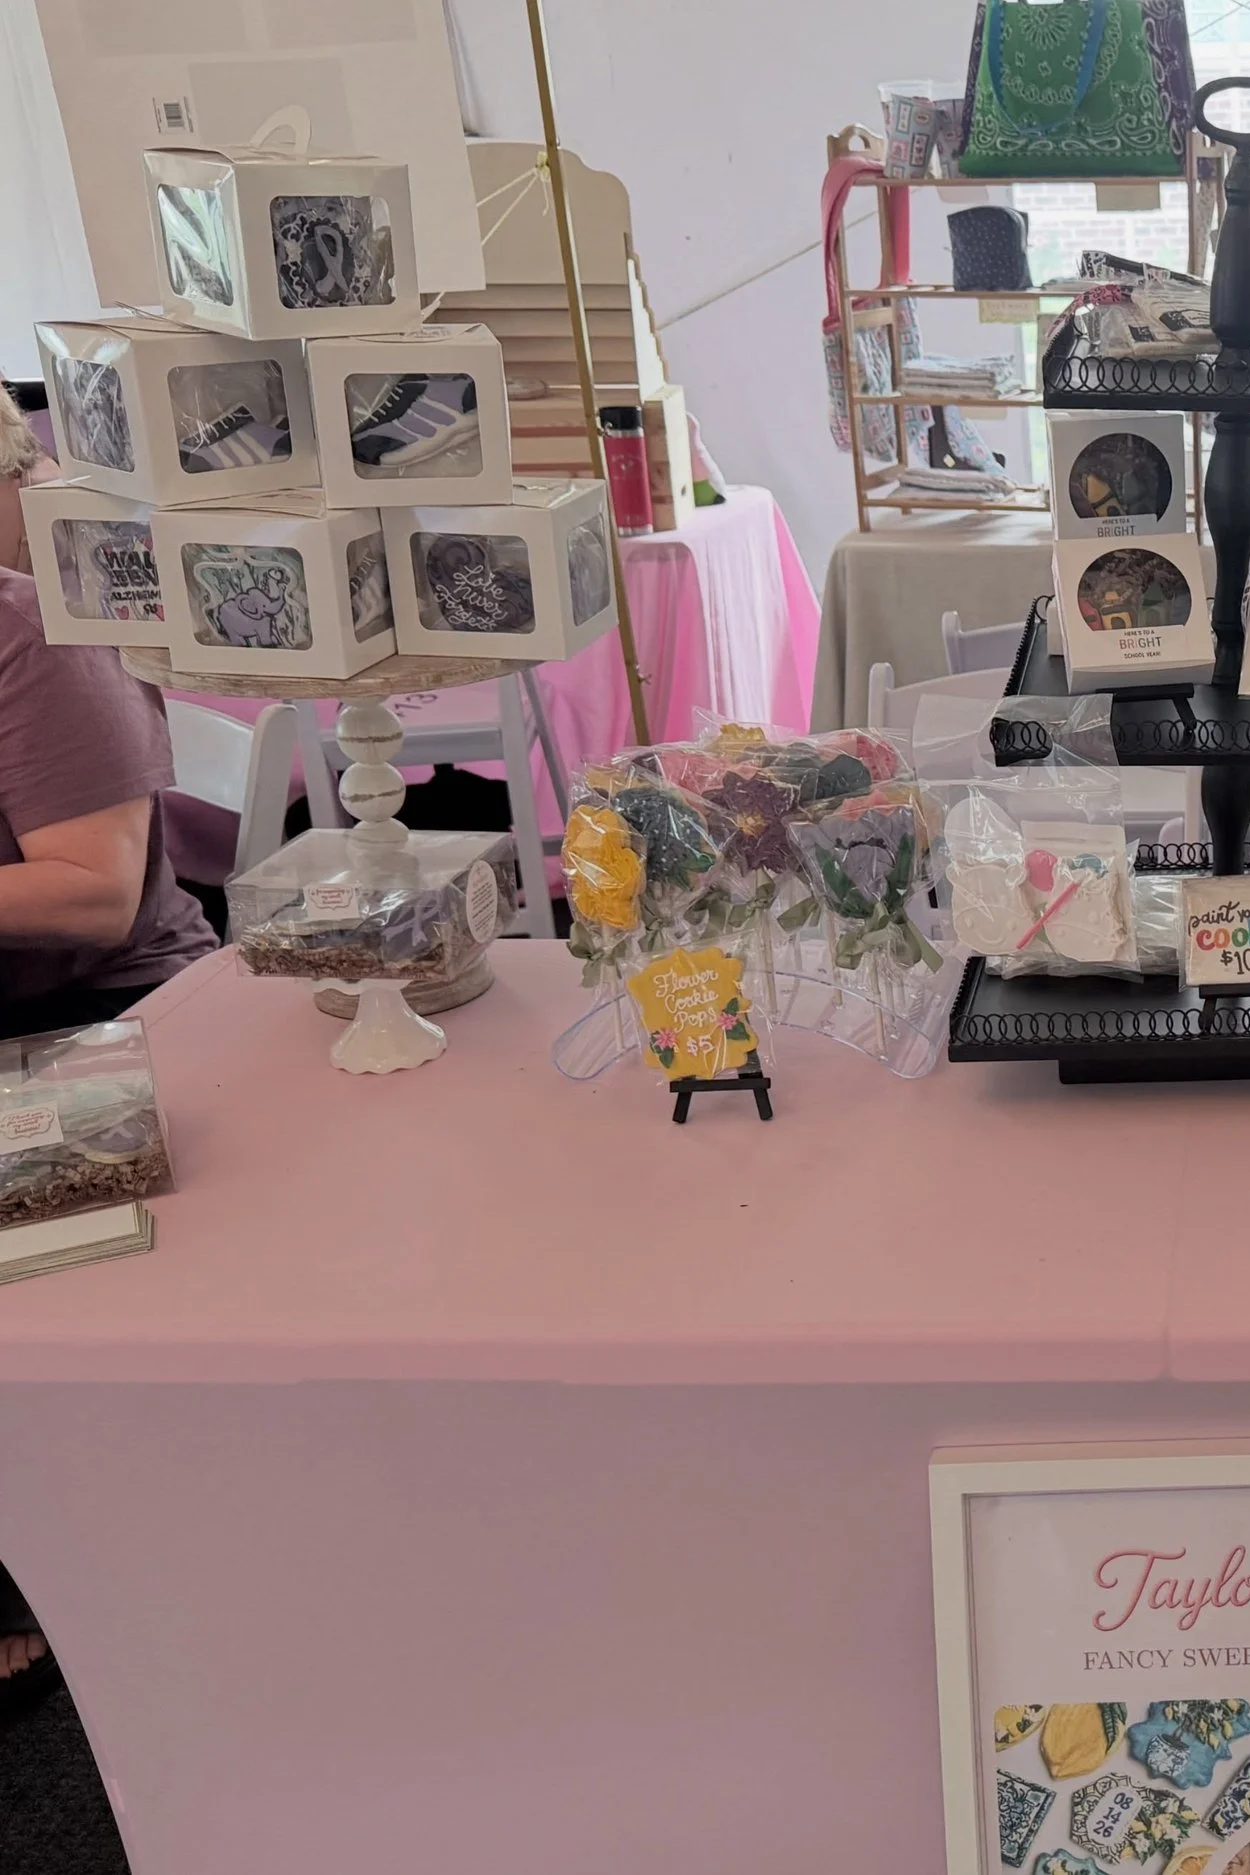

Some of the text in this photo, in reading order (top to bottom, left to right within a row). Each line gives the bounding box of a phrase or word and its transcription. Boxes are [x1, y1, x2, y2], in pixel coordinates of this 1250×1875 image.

[453, 565, 506, 600] Love
[1188, 900, 1240, 938] paint
[653, 967, 719, 998] Flower
[664, 985, 719, 1013] Cookie
[674, 1006, 717, 1033] Pops
[686, 1034, 715, 1057] $5
[1083, 1649, 1174, 1671] FANCY
[1113, 1792, 1134, 1810] 08
[1103, 1806, 1122, 1824] 14
[1093, 1820, 1114, 1838] 26
